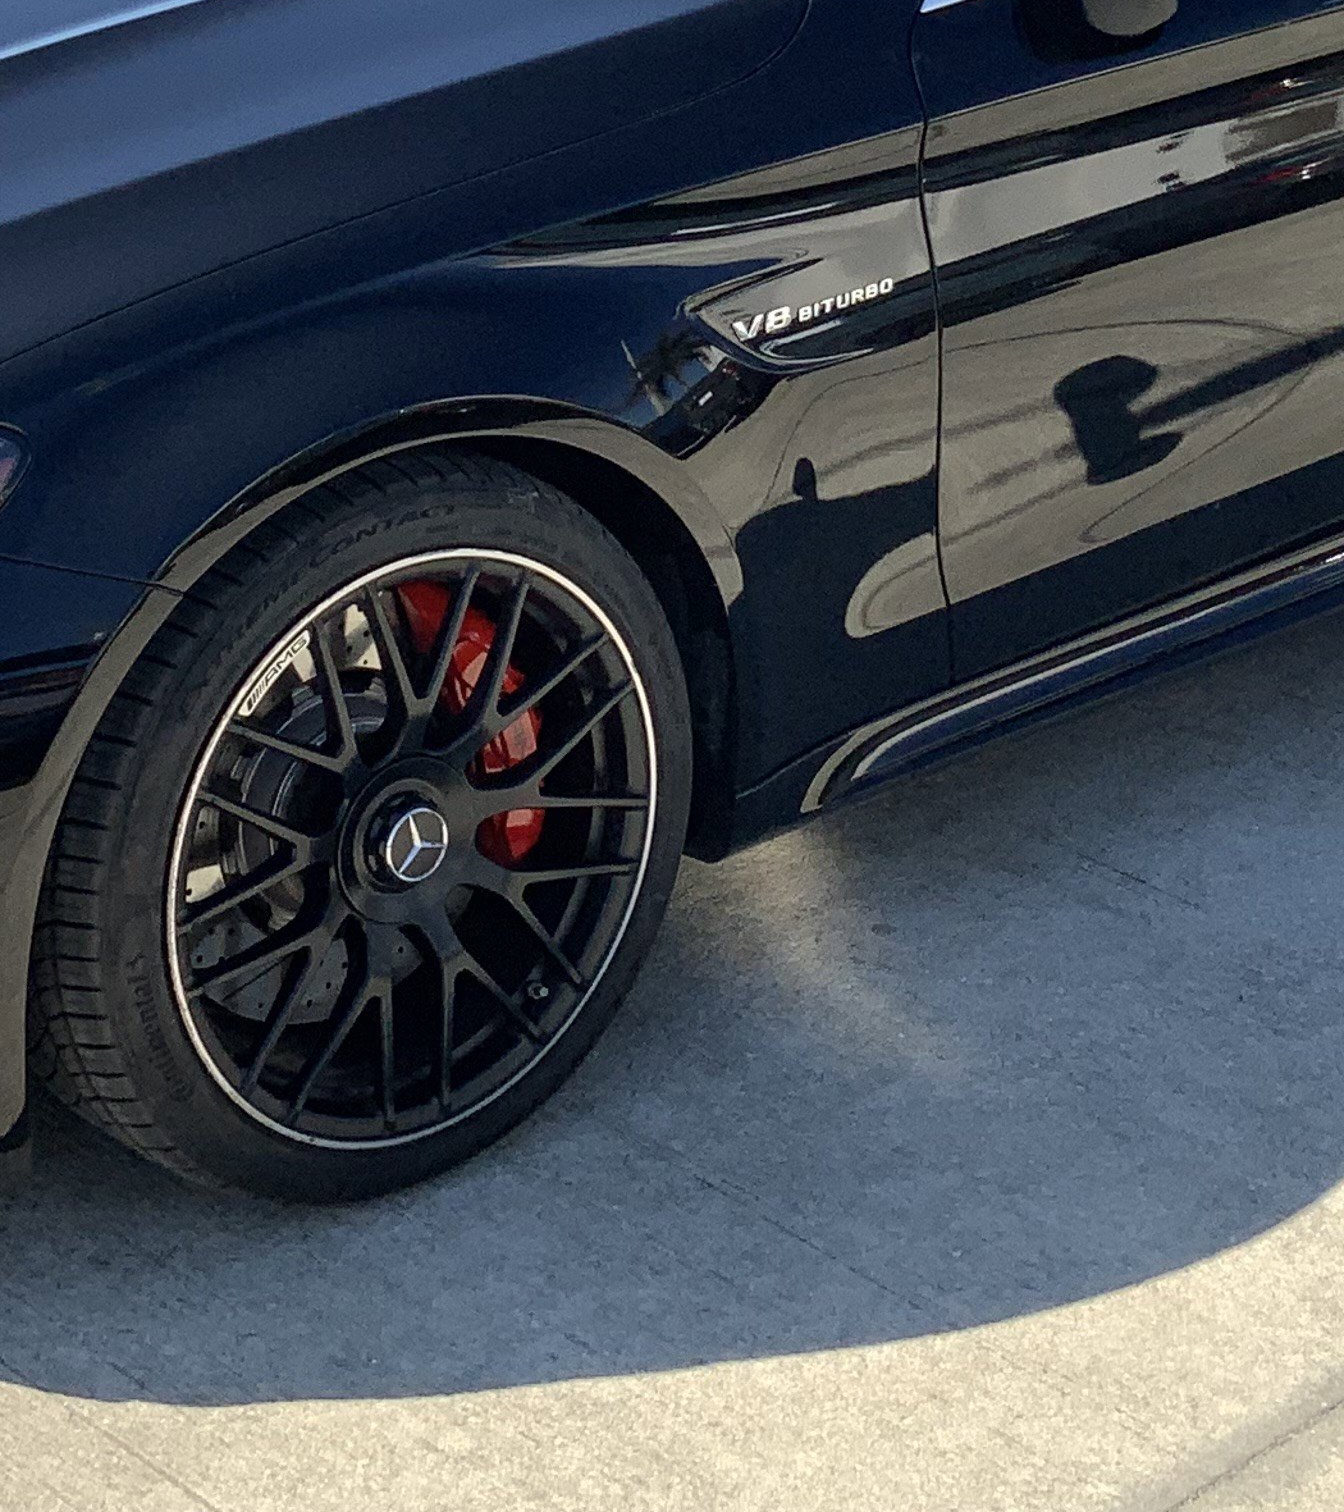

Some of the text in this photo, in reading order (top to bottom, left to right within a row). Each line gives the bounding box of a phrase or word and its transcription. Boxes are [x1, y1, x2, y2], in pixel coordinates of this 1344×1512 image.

[732, 277, 894, 342] V8 BITURBO
[262, 637, 308, 690] AMG
